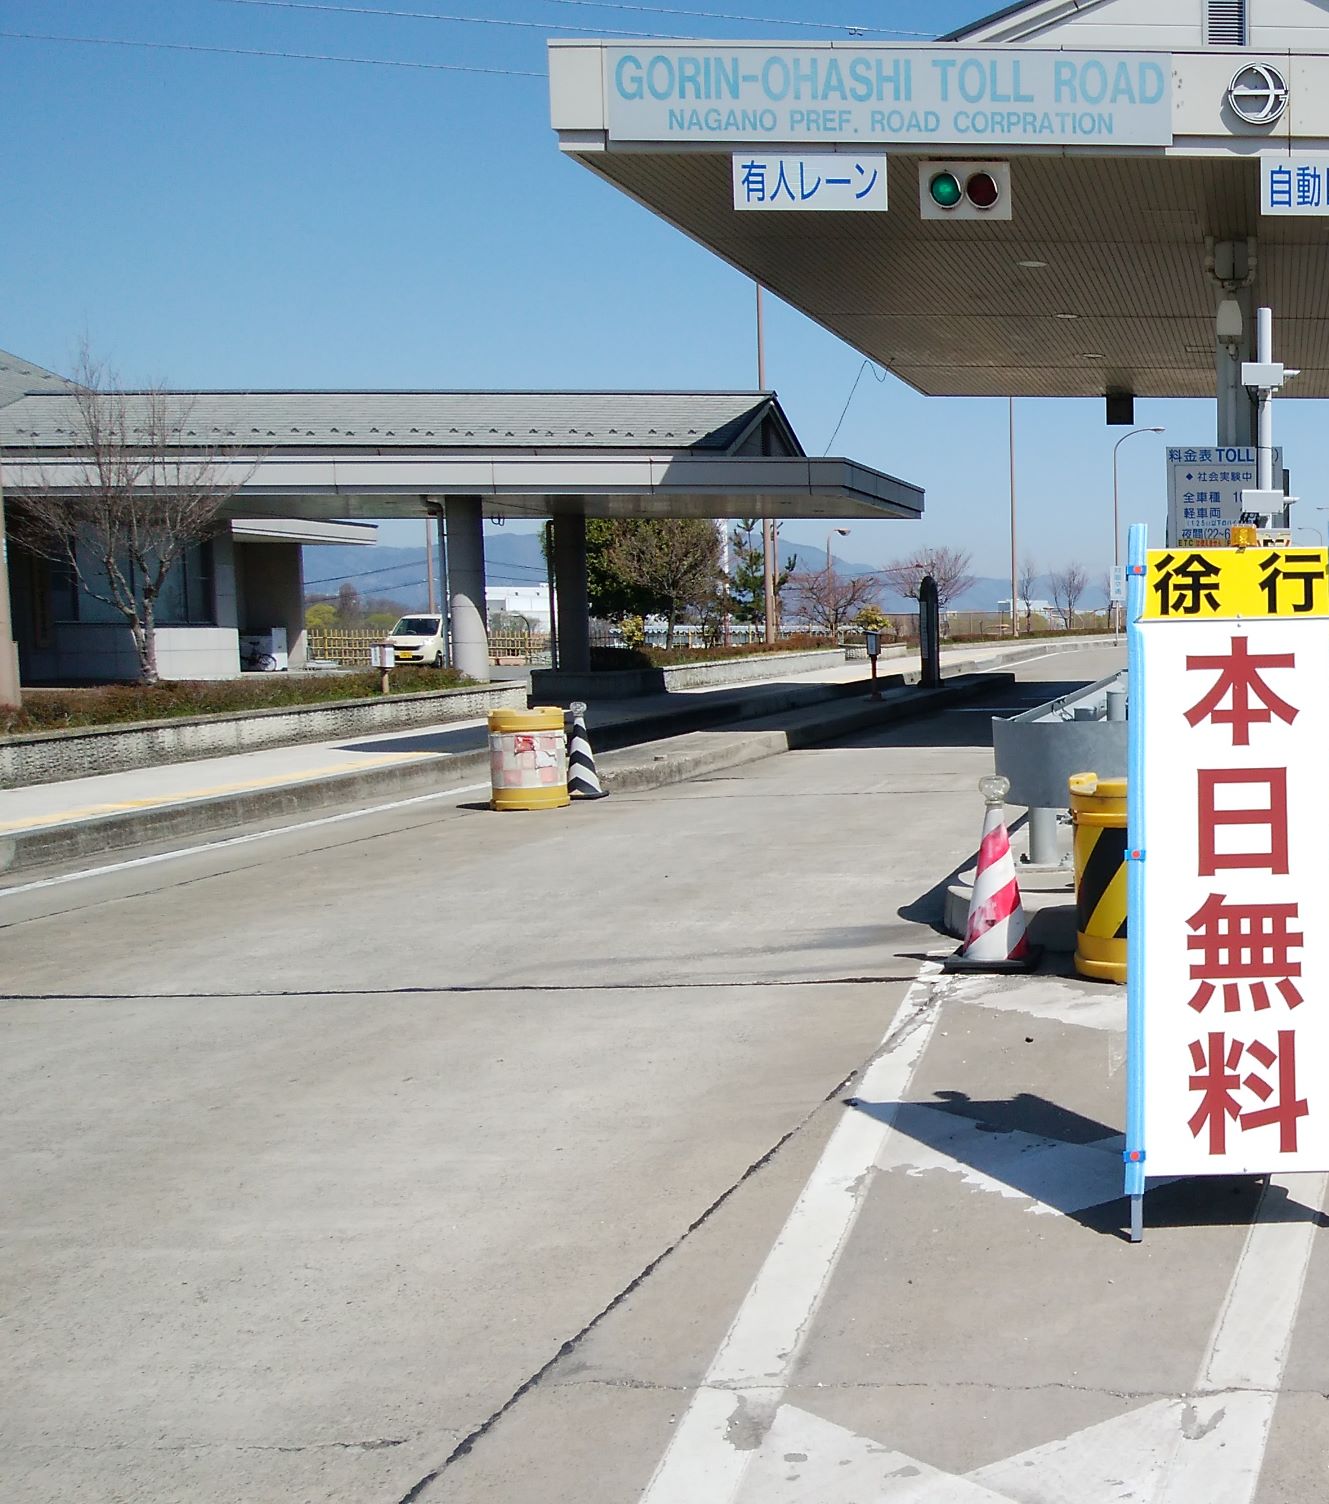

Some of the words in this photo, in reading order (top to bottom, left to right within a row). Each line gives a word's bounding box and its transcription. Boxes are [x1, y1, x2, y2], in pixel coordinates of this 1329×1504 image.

[614, 54, 912, 102] GORIN-OHASHI
[931, 57, 1039, 104] TOLL
[1054, 59, 1165, 106] ROAD
[666, 108, 777, 132] NAGANO
[789, 109, 860, 134] PREF.
[870, 110, 941, 134] ROAD
[952, 111, 1114, 135] CORPRATION
[740, 159, 878, 203] 有人レーン
[1168, 449, 1212, 463] 料金表
[1215, 448, 1255, 462] TOLL
[1197, 471, 1252, 482] 社会実験中
[1183, 491, 1221, 504] 全車種
[1183, 507, 1221, 519] 軽車両
[1153, 552, 1325, 616] 徐行
[1183, 636, 1310, 1156] 本日無料
